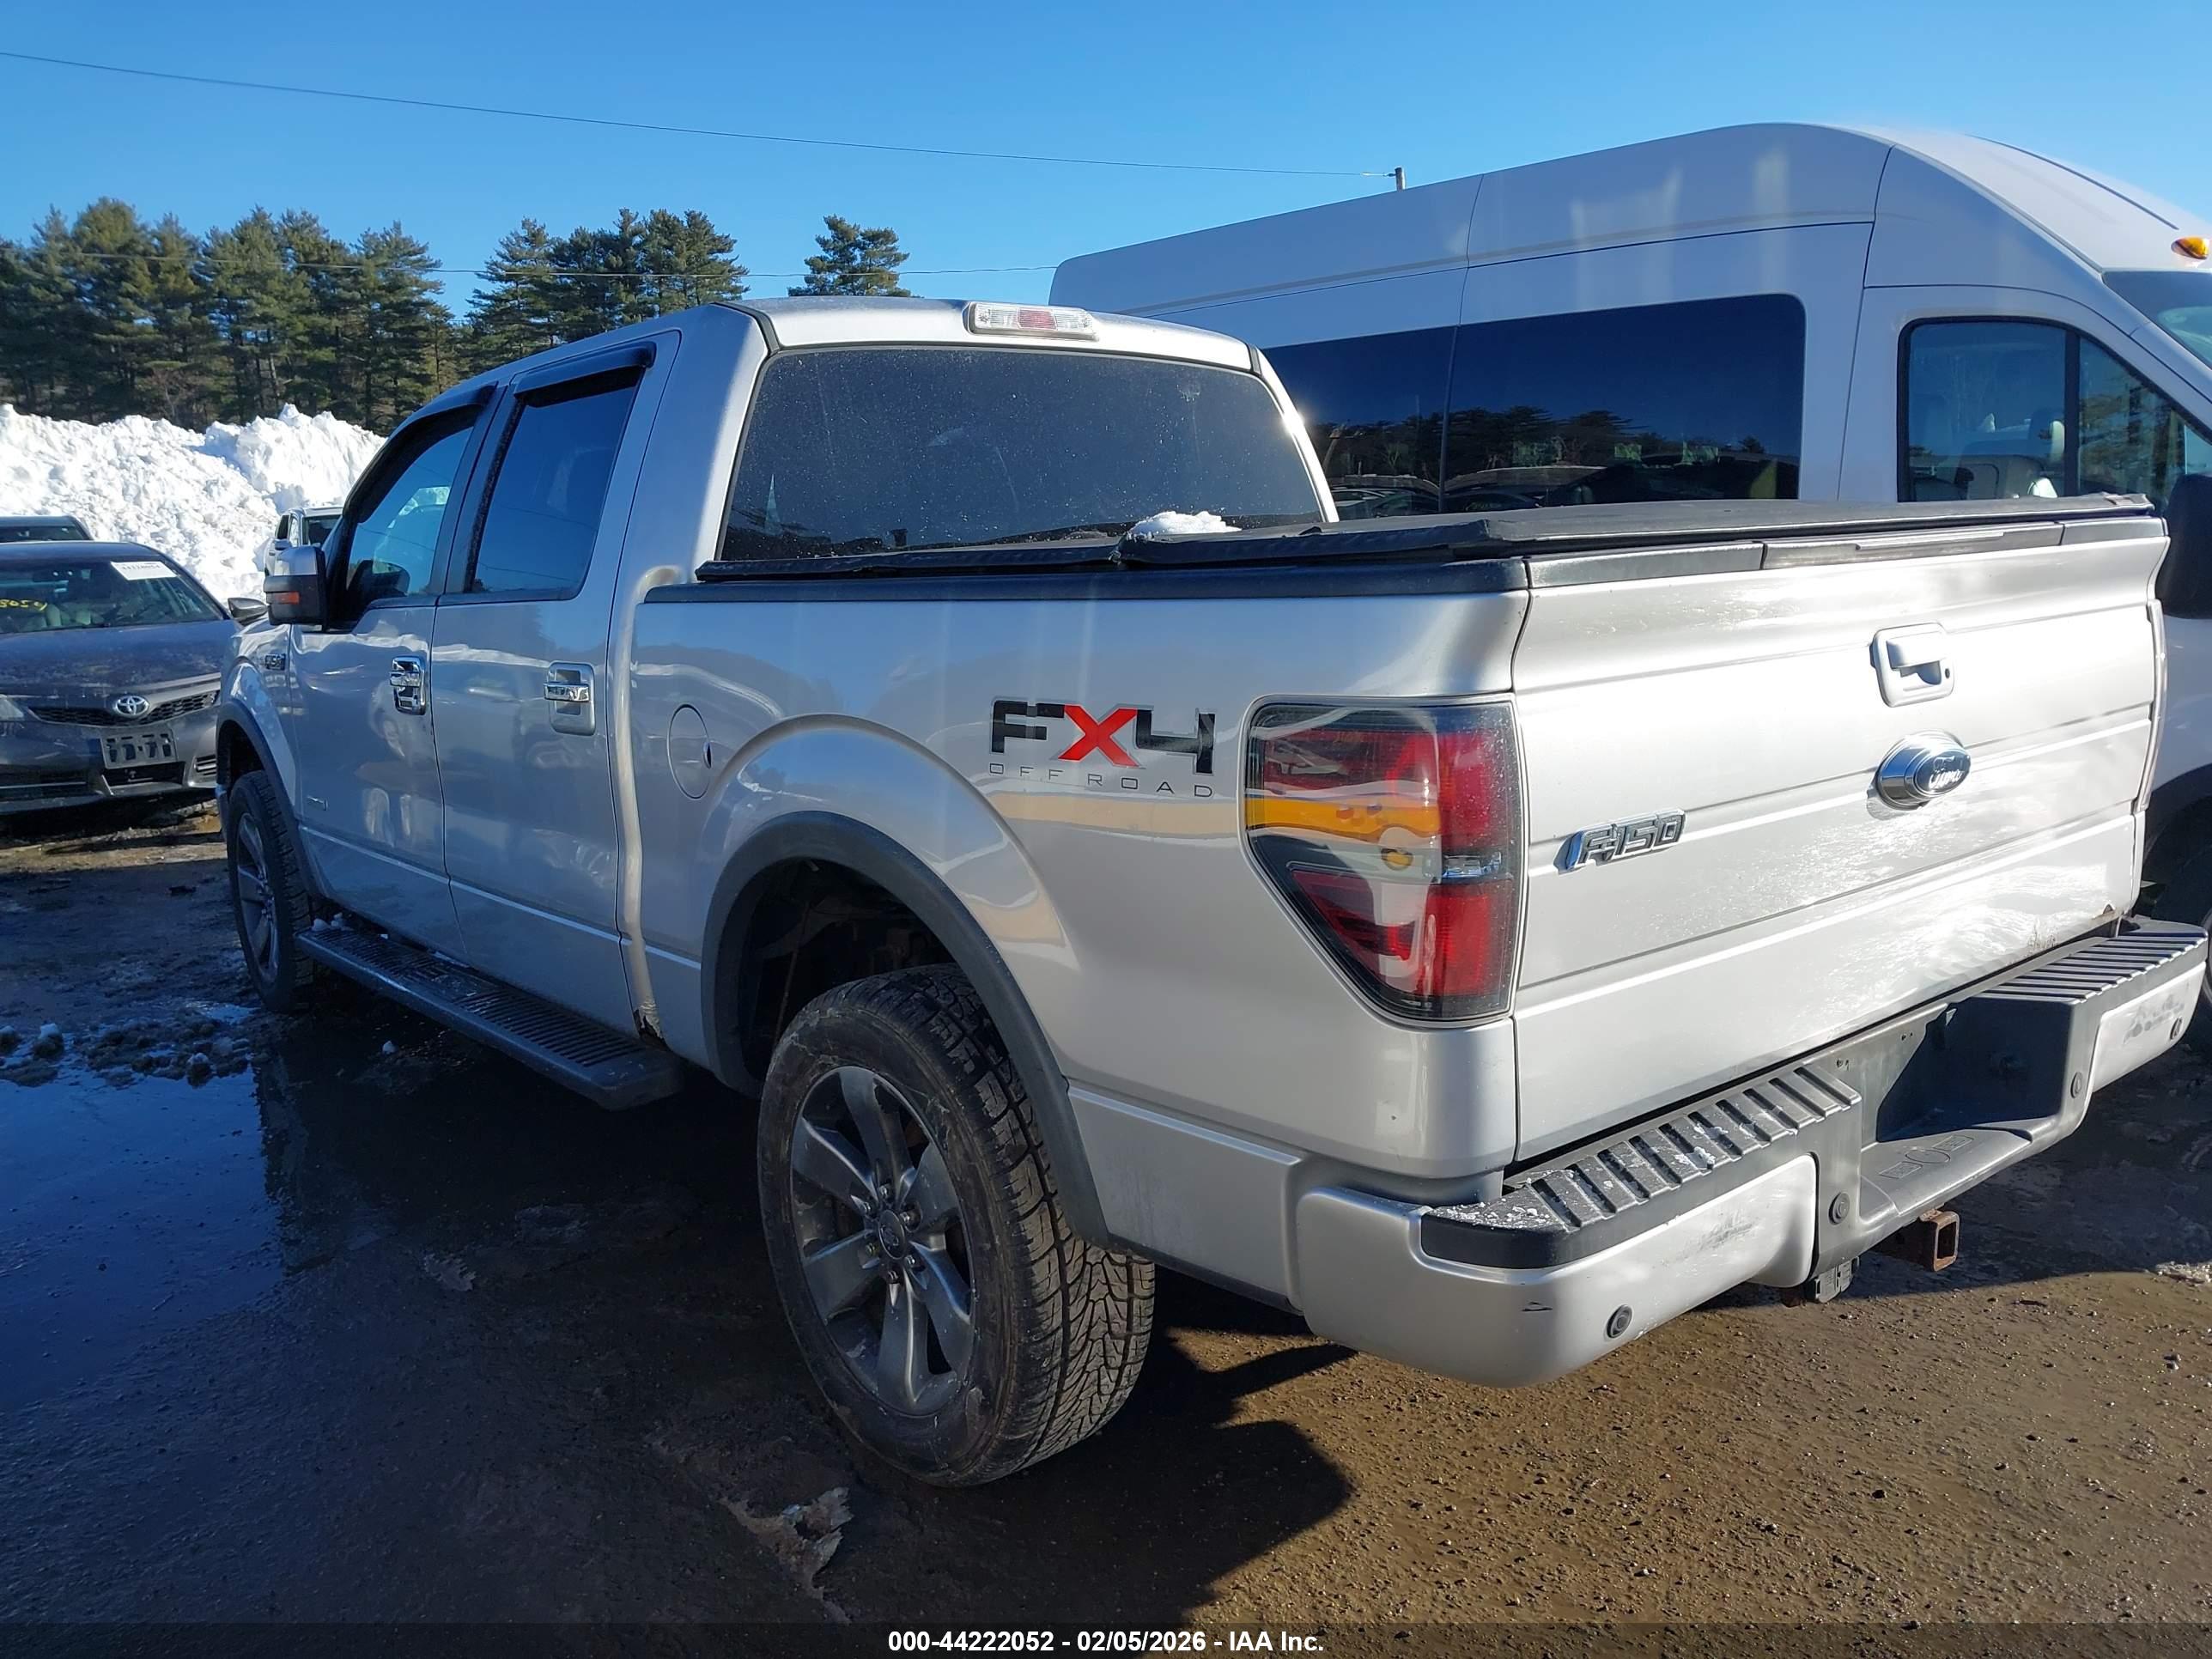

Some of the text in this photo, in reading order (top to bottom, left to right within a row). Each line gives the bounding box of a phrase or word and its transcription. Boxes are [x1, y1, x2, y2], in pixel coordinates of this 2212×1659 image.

[991, 699, 1216, 775] FX4
[989, 763, 1213, 798] OFF ROAD
[1573, 810, 1686, 868] F-150
